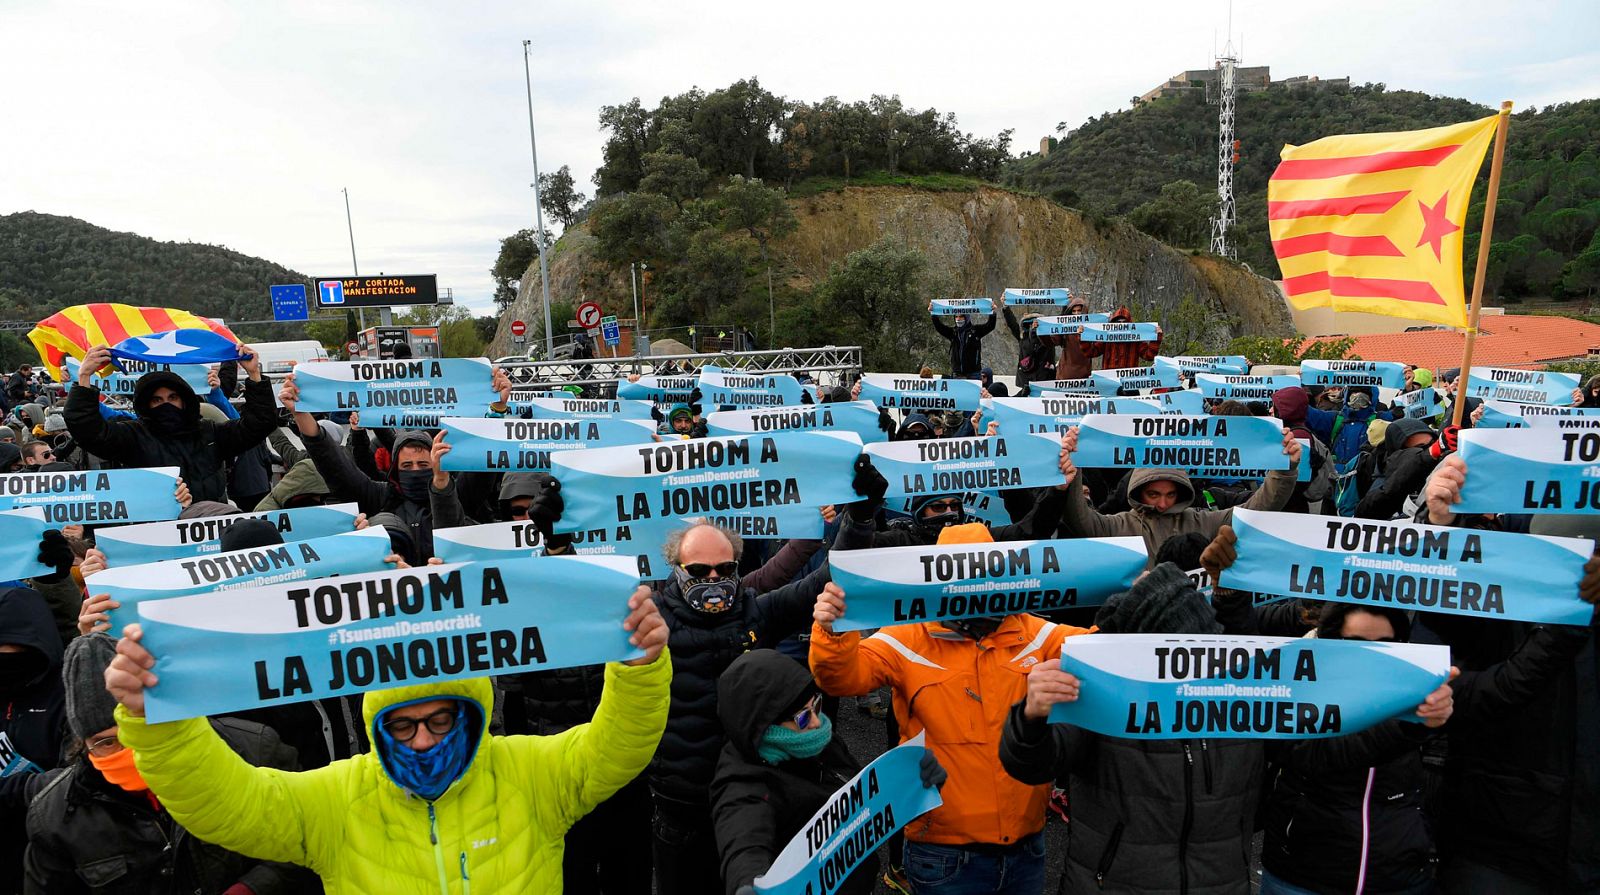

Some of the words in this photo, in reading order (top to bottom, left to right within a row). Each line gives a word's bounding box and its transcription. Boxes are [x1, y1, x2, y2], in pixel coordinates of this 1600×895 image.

[344, 280, 360, 288] AP7
[365, 279, 405, 287] CORTADA
[344, 287, 416, 296] MANIFESTACION
[1056, 315, 1083, 323] TOTHOM
[1102, 323, 1130, 331] TOTHOM
[1105, 333, 1141, 341] JONQUERA
[122, 360, 162, 374] THOM
[163, 361, 171, 374] A
[351, 361, 423, 380] TOTHOM
[430, 361, 442, 378] A
[1116, 369, 1148, 378] TOTHOM
[1327, 361, 1367, 371] TOTHOM
[1369, 362, 1376, 371] A
[723, 376, 764, 388] TOTHOM
[768, 377, 776, 388] A
[893, 379, 937, 392] TOTHOM
[940, 380, 949, 392] A
[1054, 380, 1088, 389] TOTHOM
[1088, 380, 1095, 388] A
[1225, 376, 1263, 384] TOTHOM
[1266, 376, 1273, 384] A
[1316, 375, 1329, 384] LA
[1332, 375, 1382, 386] JONQUERA
[1491, 370, 1533, 384] TOTHOM
[1536, 374, 1544, 384] A
[336, 391, 359, 408] LA
[365, 387, 457, 407] JONQUERA
[713, 393, 729, 404] LA
[729, 393, 784, 405] JONQUERA
[1215, 388, 1227, 397] LA
[1476, 386, 1489, 397] LA
[1492, 386, 1547, 402] JONQUERA
[563, 400, 609, 412] TOTHOM
[612, 401, 621, 413] A
[882, 396, 895, 407] LA
[899, 396, 956, 409] JONQUERA
[1042, 400, 1101, 416] TOTHOM
[1106, 401, 1117, 415] A
[382, 414, 397, 427] LA
[751, 410, 817, 431] TOTHOM
[823, 409, 834, 426] A
[1132, 418, 1209, 437] TOTHOM
[1214, 419, 1228, 437] A
[504, 421, 580, 441] TOTHOM
[586, 422, 600, 441] A
[486, 450, 510, 469] LA
[639, 439, 750, 475] TOTHOM
[760, 438, 779, 464] A
[918, 438, 989, 462] TOTHOM
[996, 438, 1008, 457] A
[1113, 447, 1136, 465] LA
[1142, 447, 1241, 467] JONQUERA
[96, 473, 111, 491] A
[661, 468, 760, 493] #TsunamiDemocràtic
[903, 473, 926, 494] LA
[931, 467, 1022, 492] JONQUERA
[615, 492, 651, 522] LA
[661, 477, 801, 517] JONQUERA
[1523, 480, 1562, 508] LA
[277, 512, 292, 532] A
[1326, 521, 1450, 560] TOTHOM
[1459, 533, 1483, 563] A
[181, 547, 295, 585] TOTHOM
[298, 543, 321, 564] A
[919, 548, 1031, 582] TOTHOM
[1041, 546, 1060, 574] A
[1343, 556, 1457, 577] #TsunamiDemocràtic
[942, 577, 1041, 593] #TsunamiDemocràtic
[1289, 564, 1325, 595] LA
[1336, 569, 1505, 614] JONQUERA
[287, 570, 464, 628] TOTHOM
[481, 567, 508, 606] A
[893, 597, 927, 622] LA
[936, 588, 1078, 617] JONQUERA
[327, 613, 482, 645] #TsunamiDemocràtic
[254, 655, 313, 701] LA
[328, 625, 548, 687] JONQUERA
[1155, 647, 1280, 680] TOTHOM
[1293, 649, 1317, 682] A
[1176, 683, 1292, 698] #TsunamiDemocràtic
[1125, 701, 1162, 734] LA
[1172, 700, 1341, 735] JONQUERA
[806, 778, 865, 859] TOTHOM
[868, 767, 880, 800] A
[818, 803, 896, 895] JONQUERA
